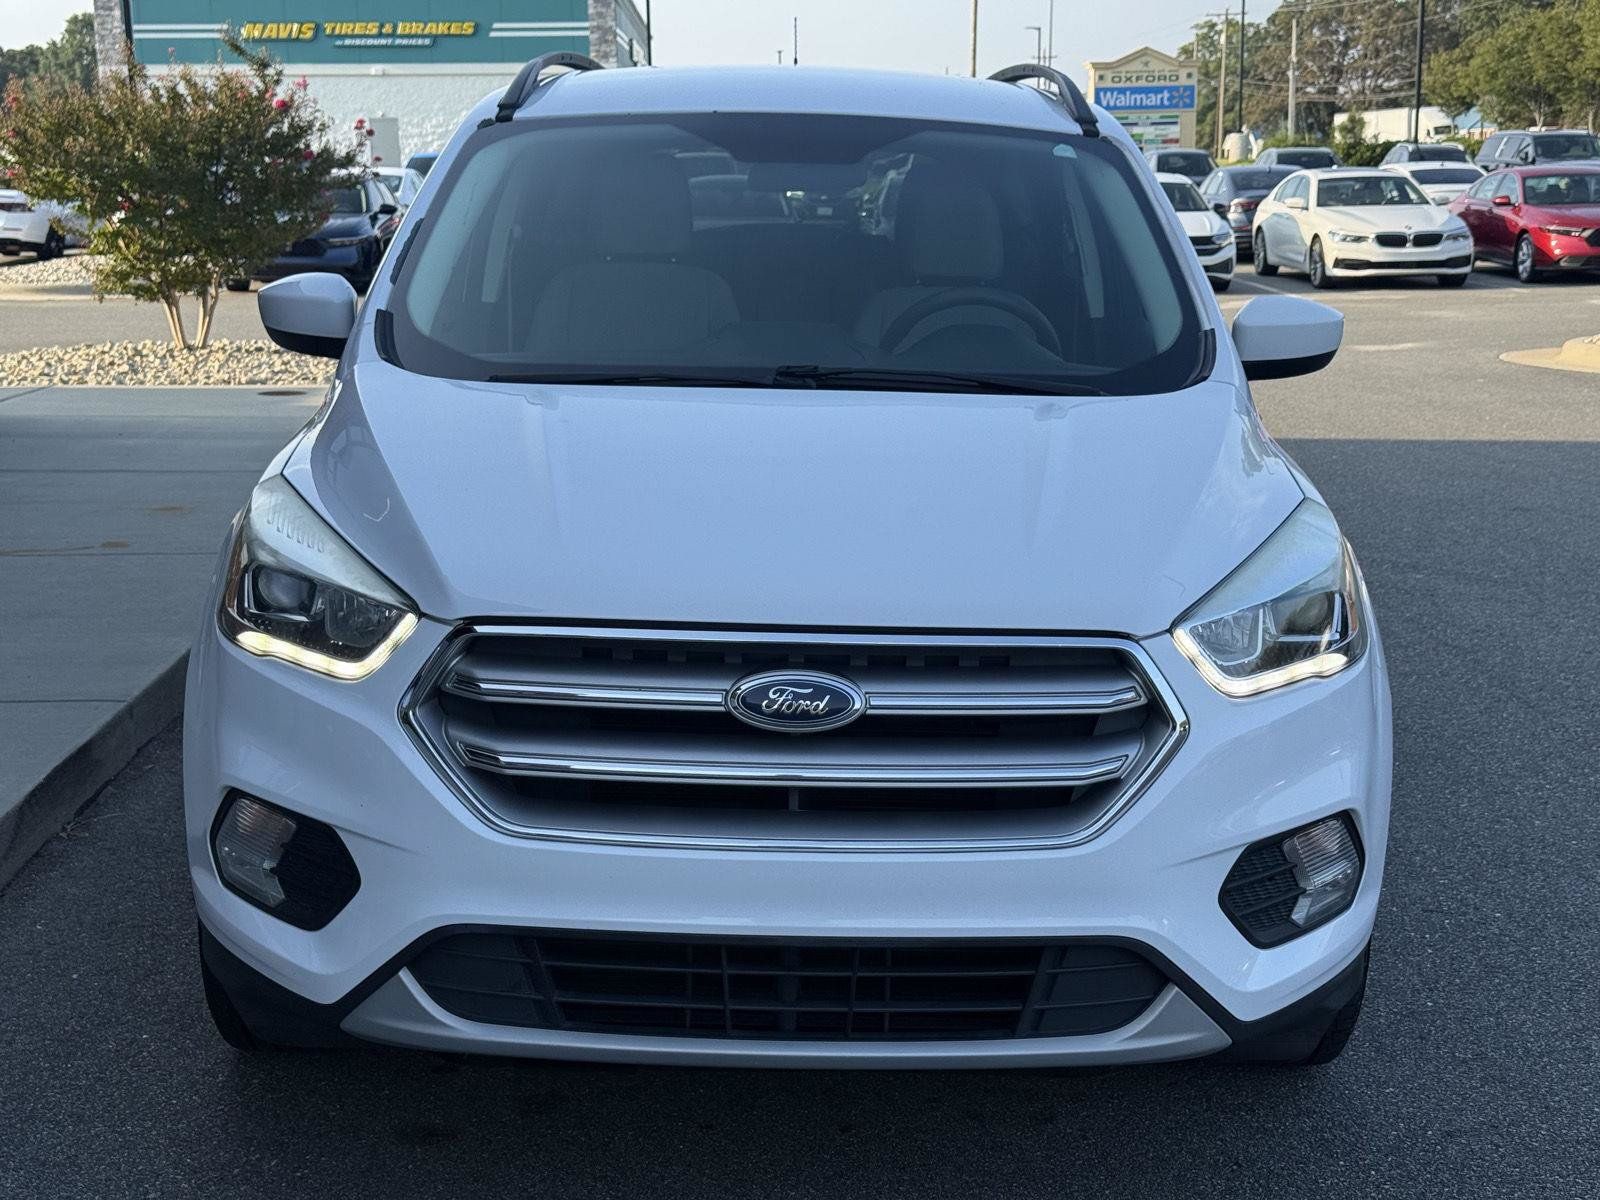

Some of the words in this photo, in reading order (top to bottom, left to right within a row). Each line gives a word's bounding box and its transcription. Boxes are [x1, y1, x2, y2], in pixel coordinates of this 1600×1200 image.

[242, 22, 315, 40] MAVIS
[324, 22, 379, 35] TIRES
[381, 23, 394, 34] &
[396, 21, 475, 35] BRAKES
[343, 38, 393, 46] DISCOUNT
[395, 38, 431, 46] PRICES
[1111, 74, 1180, 84] OXFORD
[1099, 90, 1170, 107] Walmart
[761, 685, 831, 715] Ford
